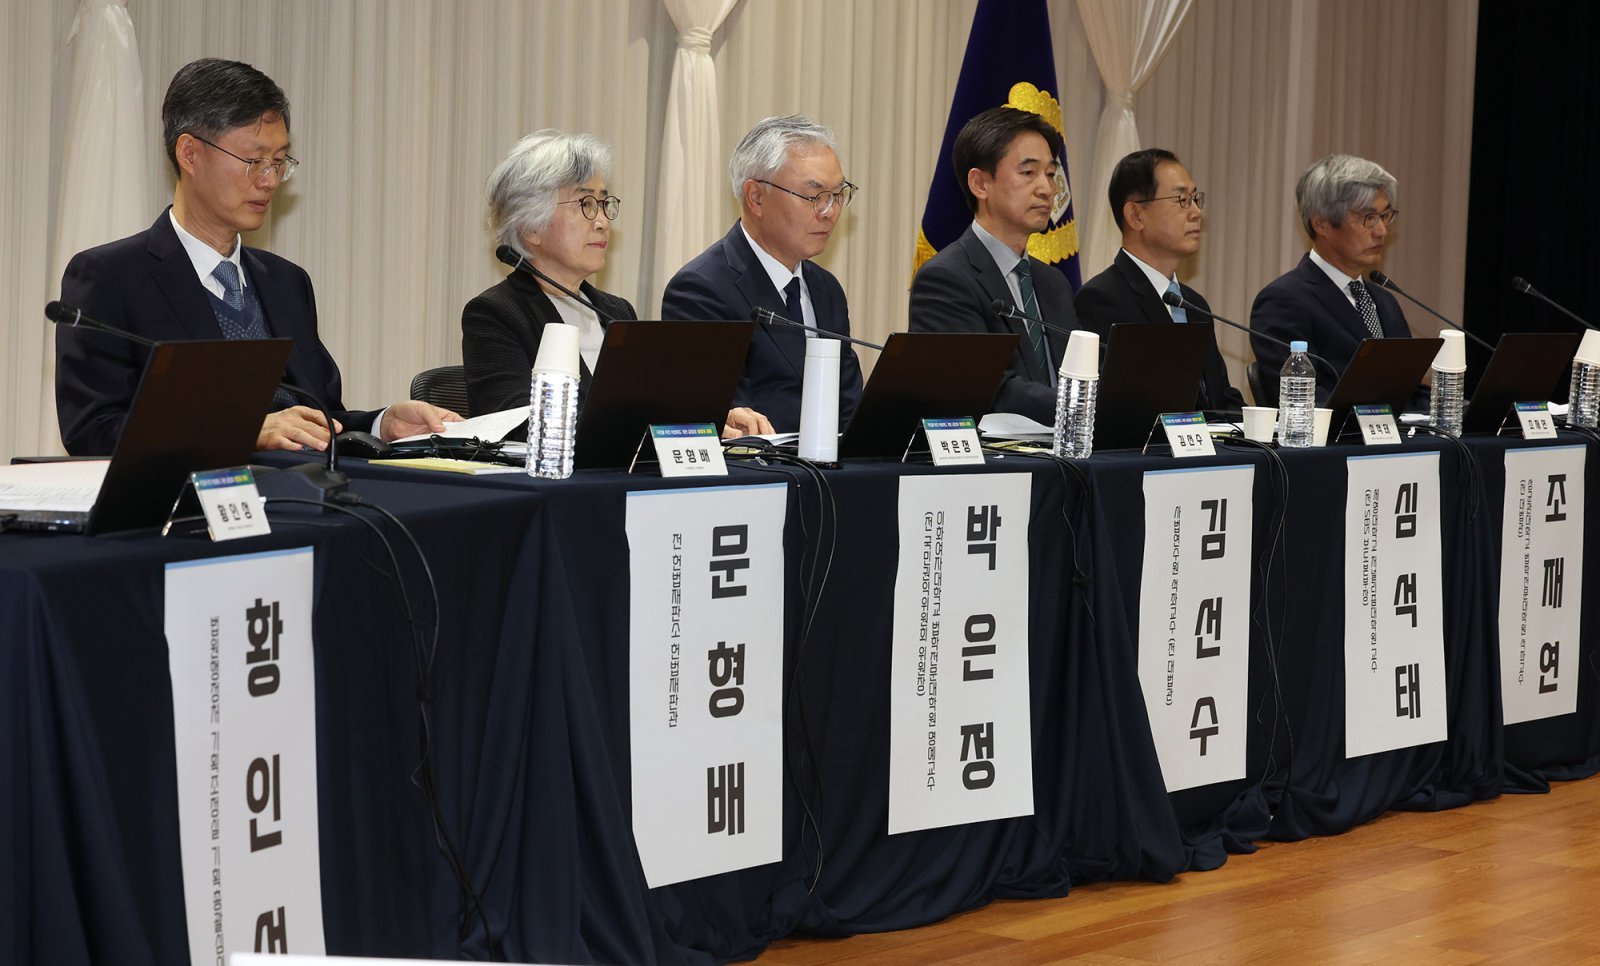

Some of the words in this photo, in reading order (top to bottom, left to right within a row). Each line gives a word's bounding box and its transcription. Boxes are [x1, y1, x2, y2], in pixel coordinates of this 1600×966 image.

[672, 448, 711, 464] 문형배
[940, 439, 971, 454] 박은정
[673, 533, 683, 550] 전
[924, 512, 934, 531] (전
[1172, 506, 1183, 575] 사법연수원
[1363, 510, 1371, 535] SBS
[671, 554, 681, 638] 헌법재판소
[919, 536, 932, 641] 국민권익위원회
[932, 511, 944, 616] 이화여자대학교
[1539, 473, 1566, 695] 조재연
[1169, 579, 1178, 634] 석좌교수
[1189, 499, 1227, 757] 김선수
[1393, 482, 1420, 720] 심석태
[708, 525, 750, 836] 문형배
[914, 646, 926, 697] 위원장)
[929, 621, 940, 727] 법학전문대학원
[959, 504, 1002, 791] 박은정
[1371, 648, 1379, 673] 교수
[669, 643, 681, 728] 헌법재판관
[1166, 660, 1175, 706] 대법관)
[927, 731, 937, 792] 명예교수
